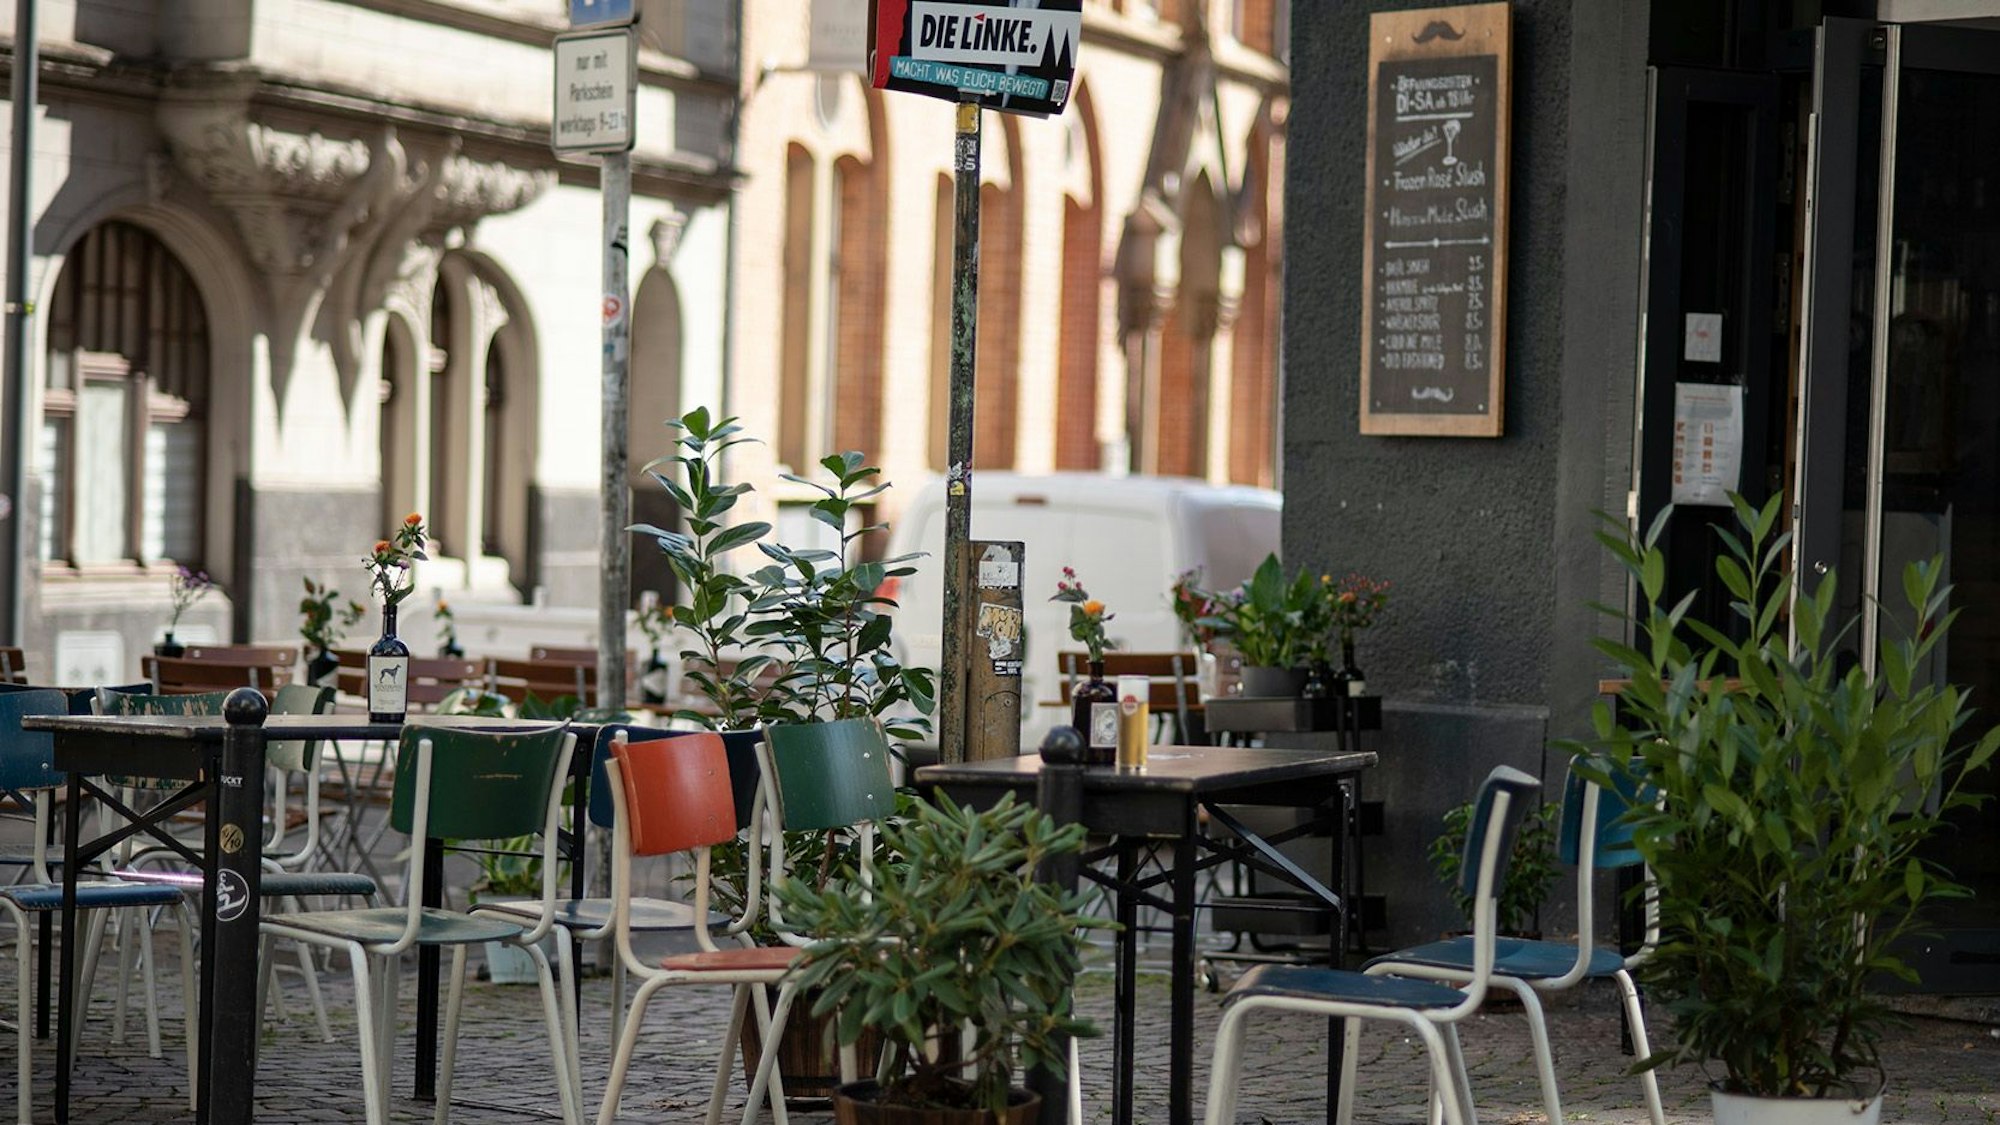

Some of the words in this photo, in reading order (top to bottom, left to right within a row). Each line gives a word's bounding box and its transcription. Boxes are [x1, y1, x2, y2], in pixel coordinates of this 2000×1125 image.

[920, 14, 959, 49] DIE
[576, 56, 590, 70] nur
[594, 50, 608, 69] mit
[570, 82, 613, 102] Parkschein
[935, 67, 959, 85] WAS
[964, 71, 995, 89] EUCH
[998, 77, 1046, 98] BEWEGT!
[560, 113, 596, 137] werktags
[1455, 161, 1486, 187] Slush
[1455, 196, 1487, 222] Slush
